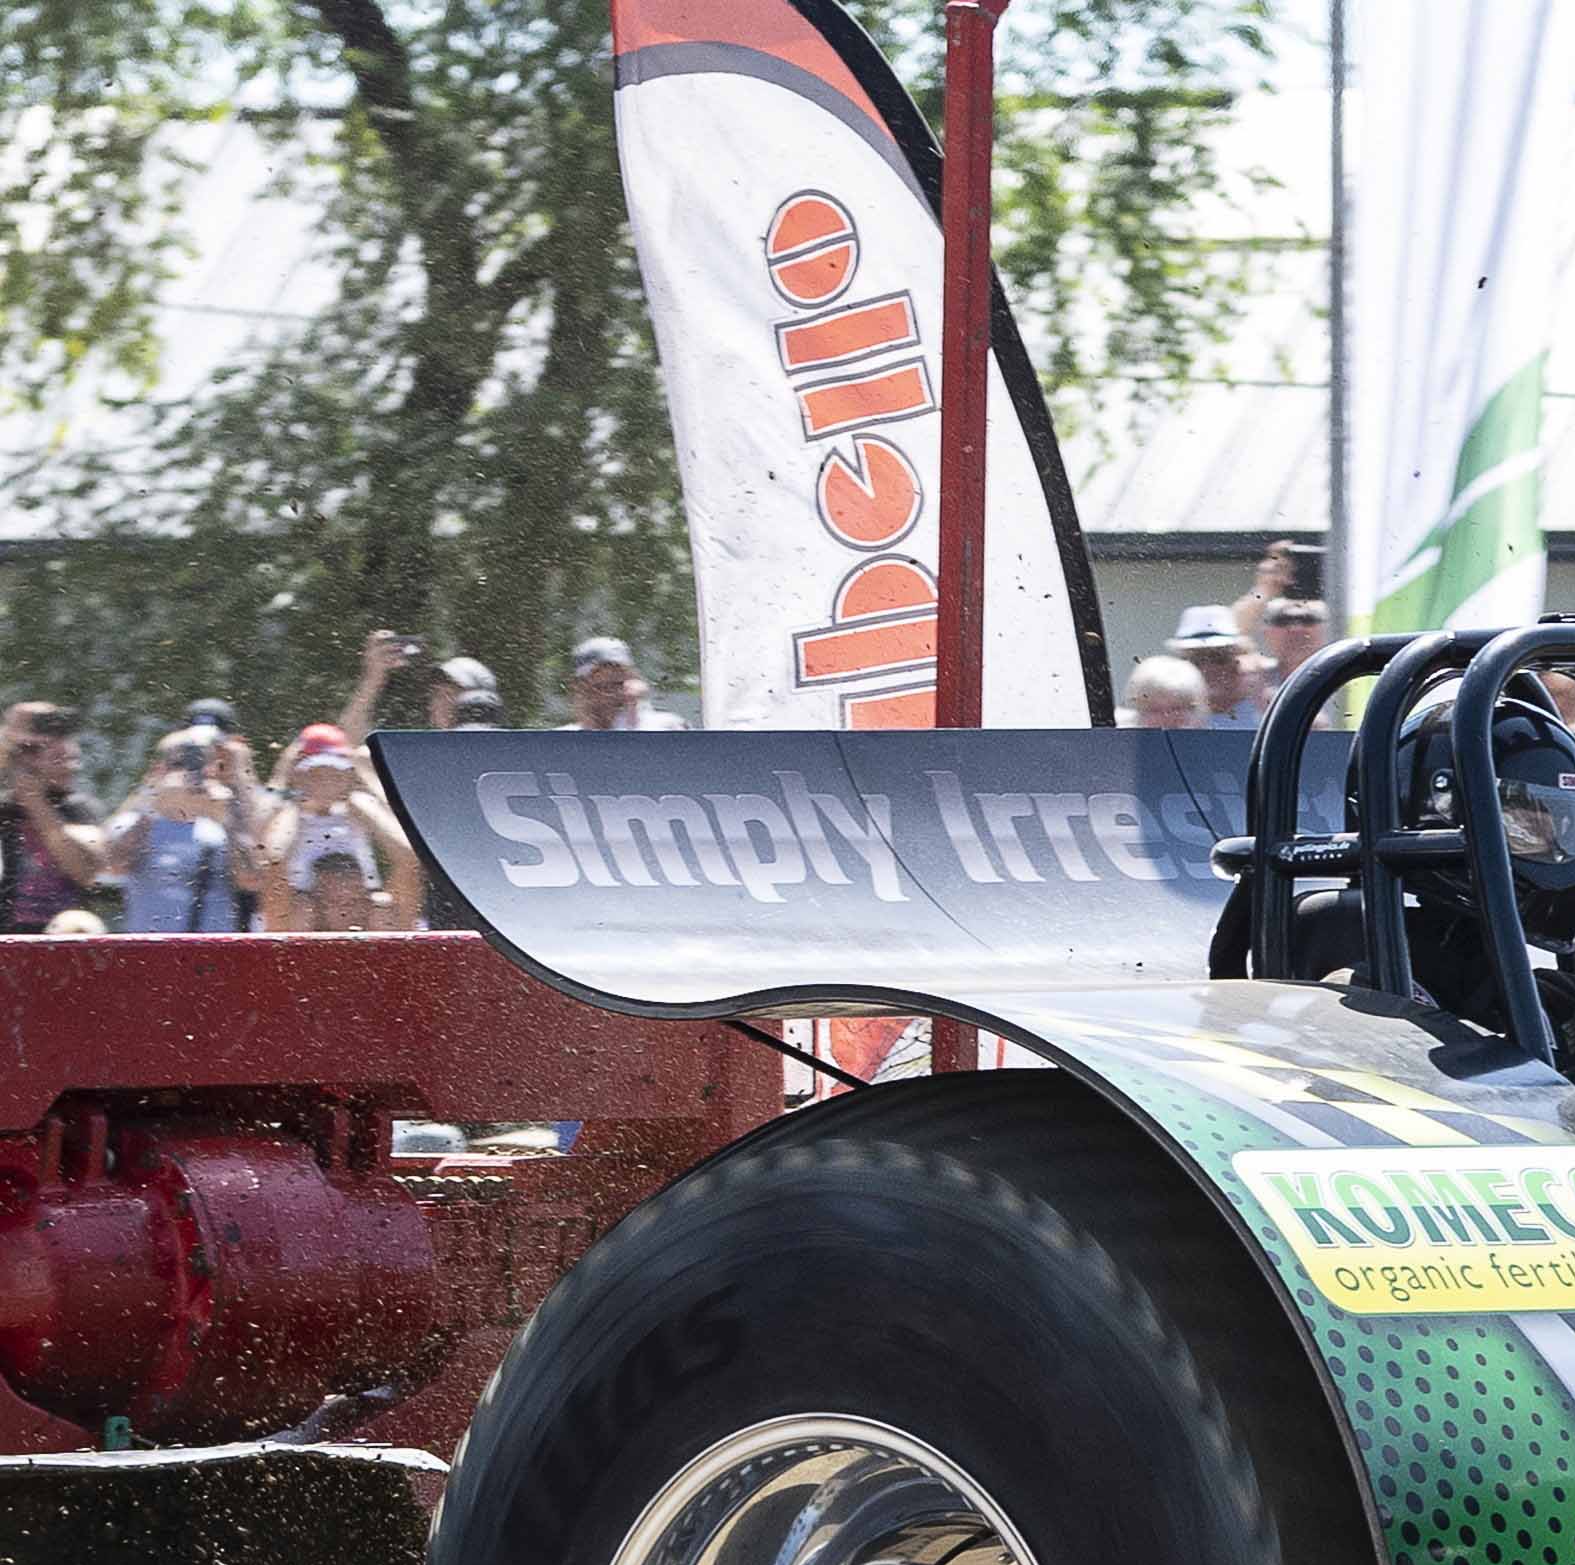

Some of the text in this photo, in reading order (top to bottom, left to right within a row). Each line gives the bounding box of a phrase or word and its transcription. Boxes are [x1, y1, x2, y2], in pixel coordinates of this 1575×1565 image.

[476, 770, 1250, 902] Simply Irresi
[1335, 1256, 1483, 1301] organic
